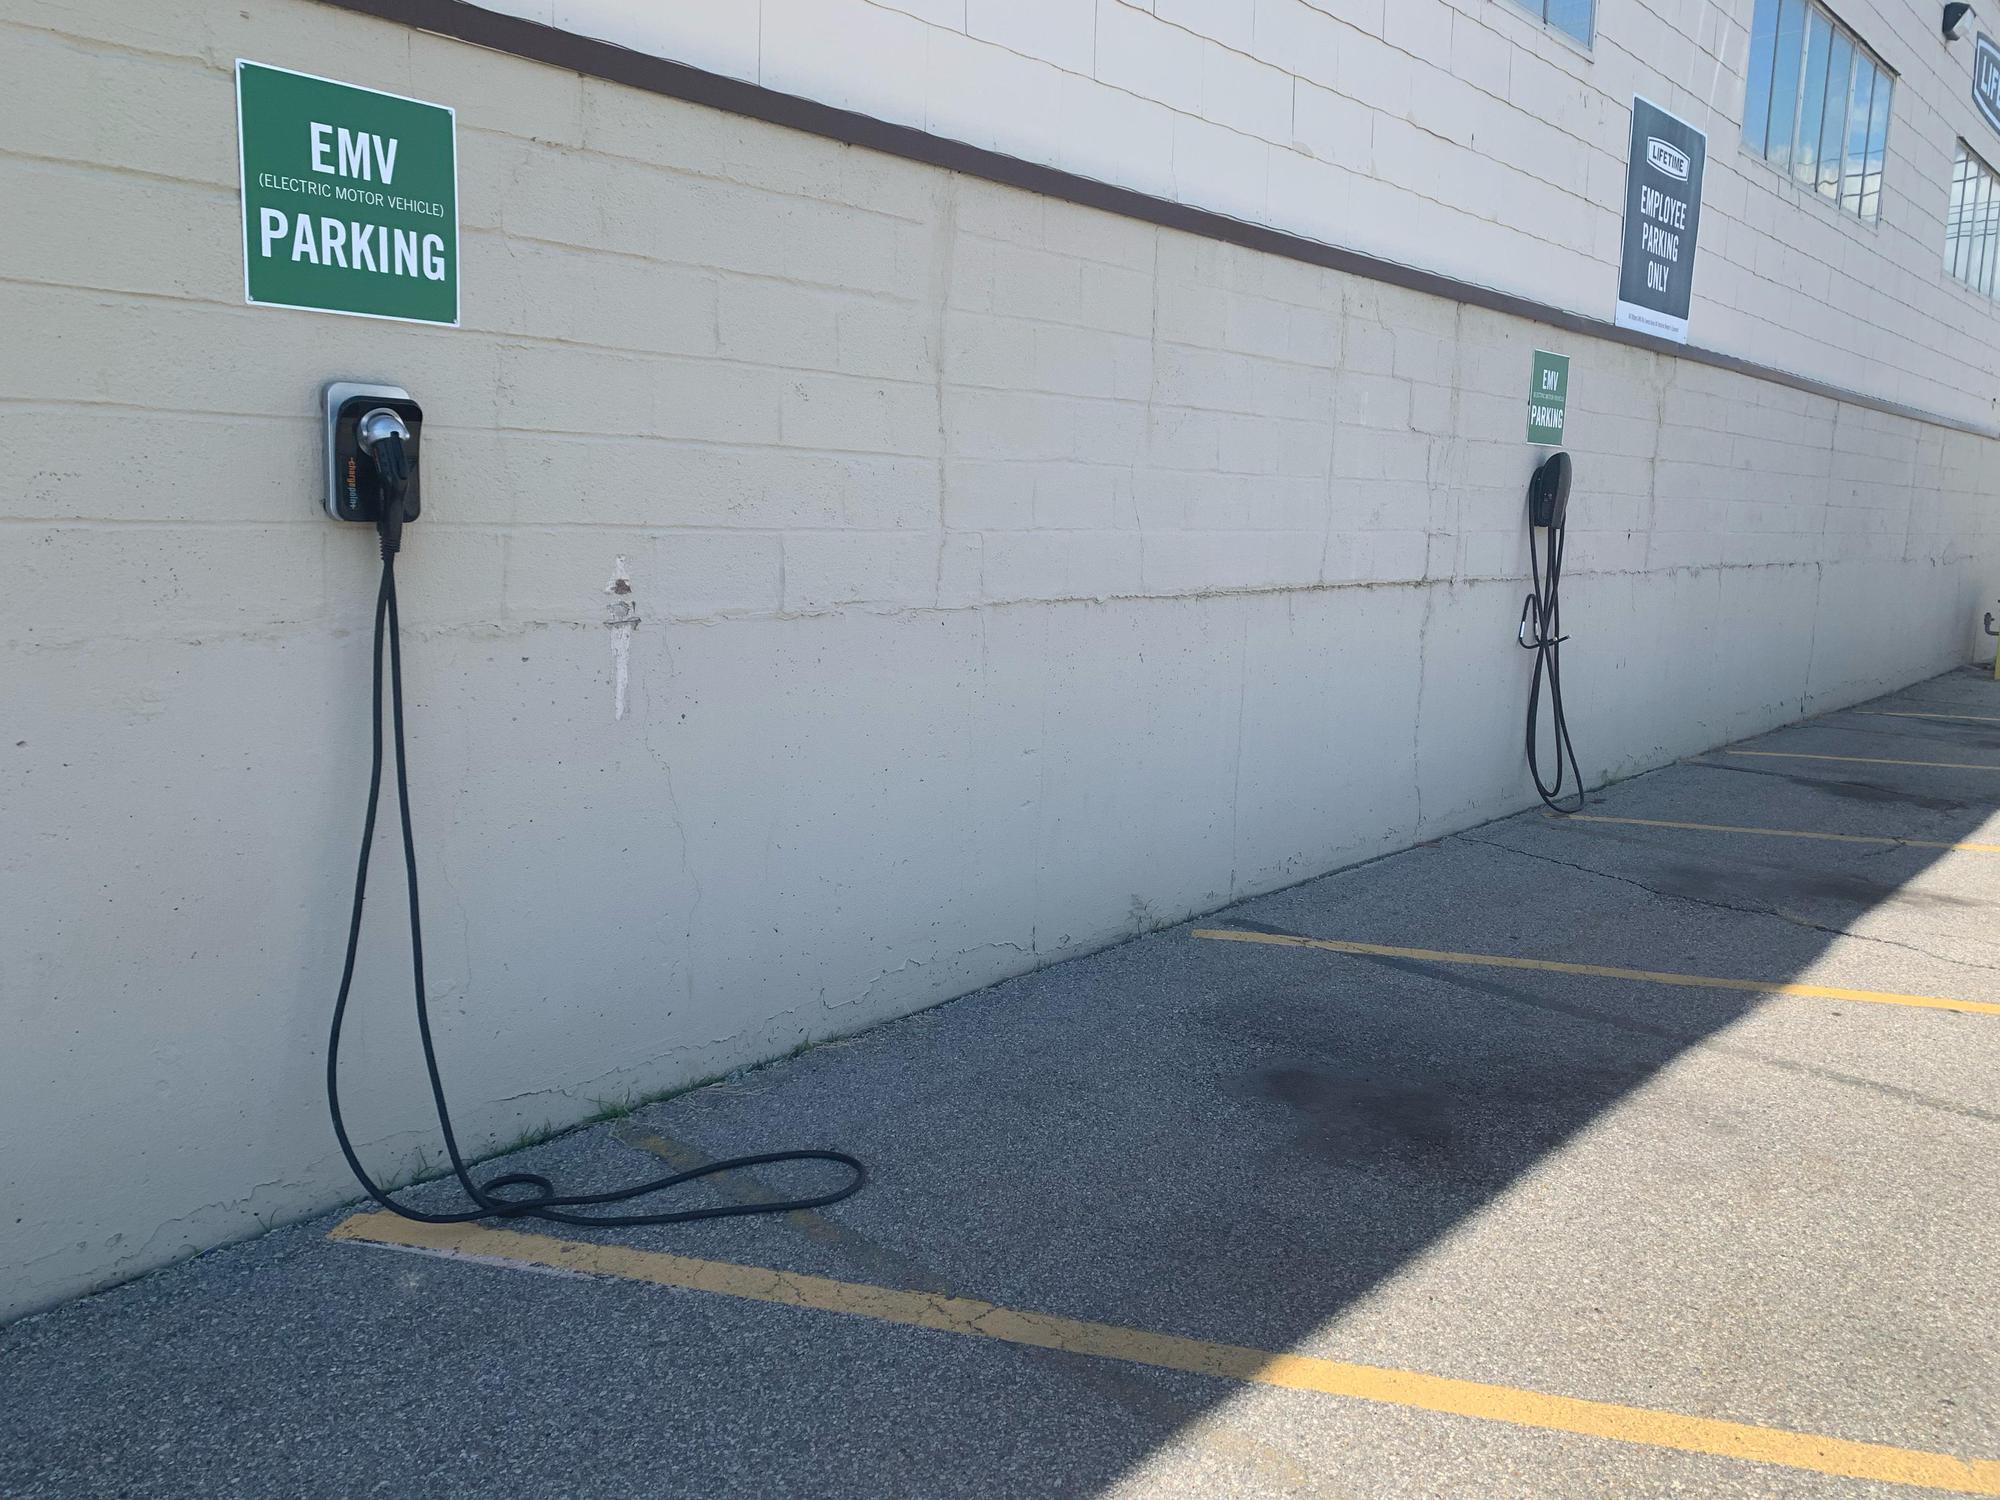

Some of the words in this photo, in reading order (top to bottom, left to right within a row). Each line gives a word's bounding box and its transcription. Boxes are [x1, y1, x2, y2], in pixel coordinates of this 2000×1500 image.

[310, 121, 398, 185] EMV
[1652, 144, 1684, 173] LIFETIME
[259, 172, 331, 198] (ELECTRIC
[335, 186, 384, 207] MOTOR
[387, 195, 444, 218] VEHICLE)
[1640, 184, 1687, 231] EMPLOYEE
[260, 206, 445, 282] PARKING
[1641, 222, 1680, 263] PARKING
[1647, 260, 1670, 294] ONLY
[1542, 368, 1559, 391] EMV
[1530, 404, 1563, 429] PARKING
